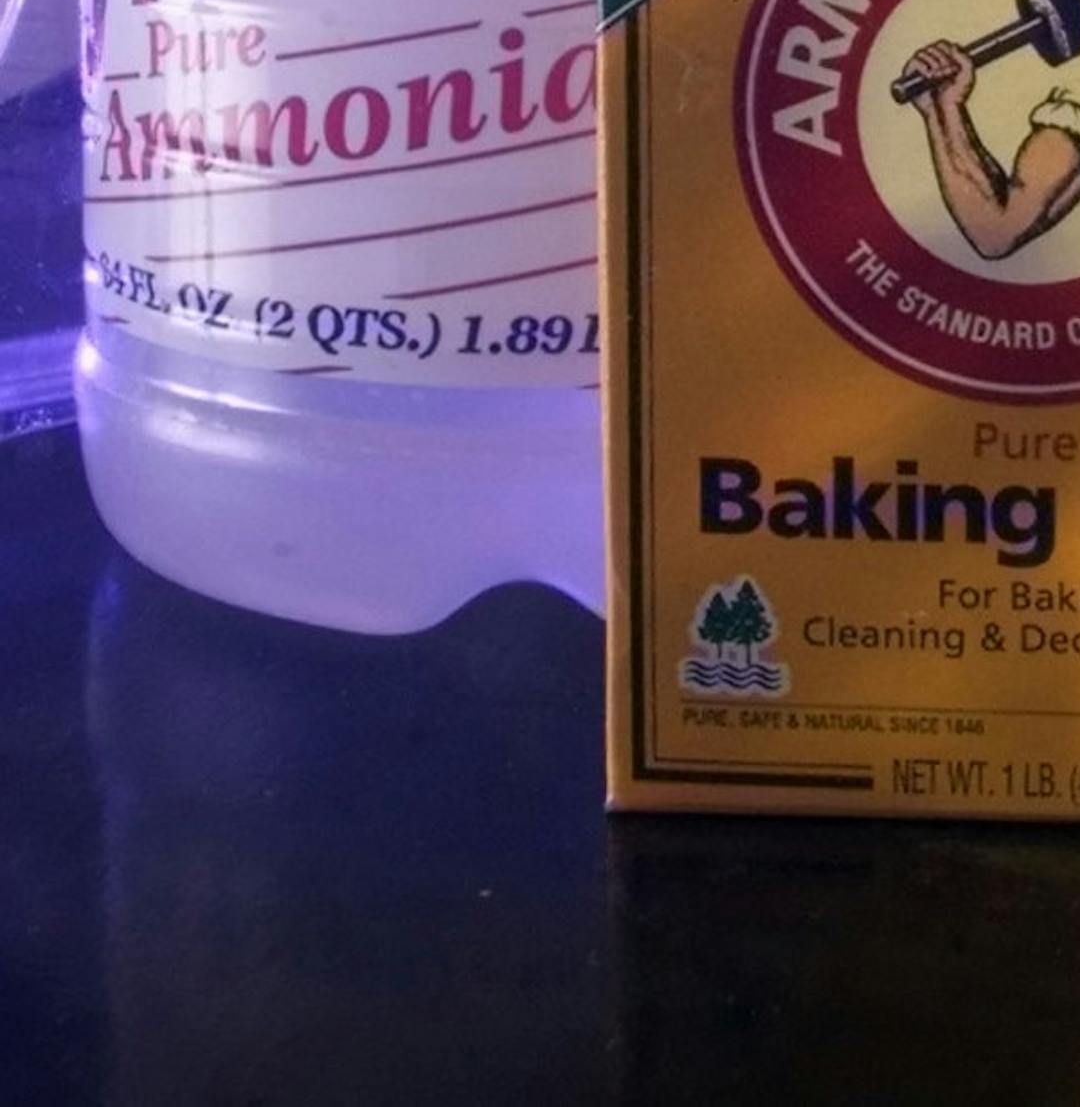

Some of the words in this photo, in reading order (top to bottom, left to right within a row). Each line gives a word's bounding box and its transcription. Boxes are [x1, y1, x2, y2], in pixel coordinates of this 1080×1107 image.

[147, 21, 267, 77] Pure
[845, 240, 900, 294] THE
[898, 290, 1055, 350] STANDARD
[307, 303, 441, 359] QTS.)
[974, 422, 1079, 461] Pure
[700, 457, 1057, 566] Baking
[938, 580, 993, 611] For
[803, 617, 965, 659] Cleaning
[980, 626, 1006, 653] &
[804, 713, 886, 733] NATURAL
[890, 716, 941, 735] SINCE
[893, 759, 940, 795] NET
[946, 760, 995, 796] WT.
[1002, 764, 1014, 796] 1
